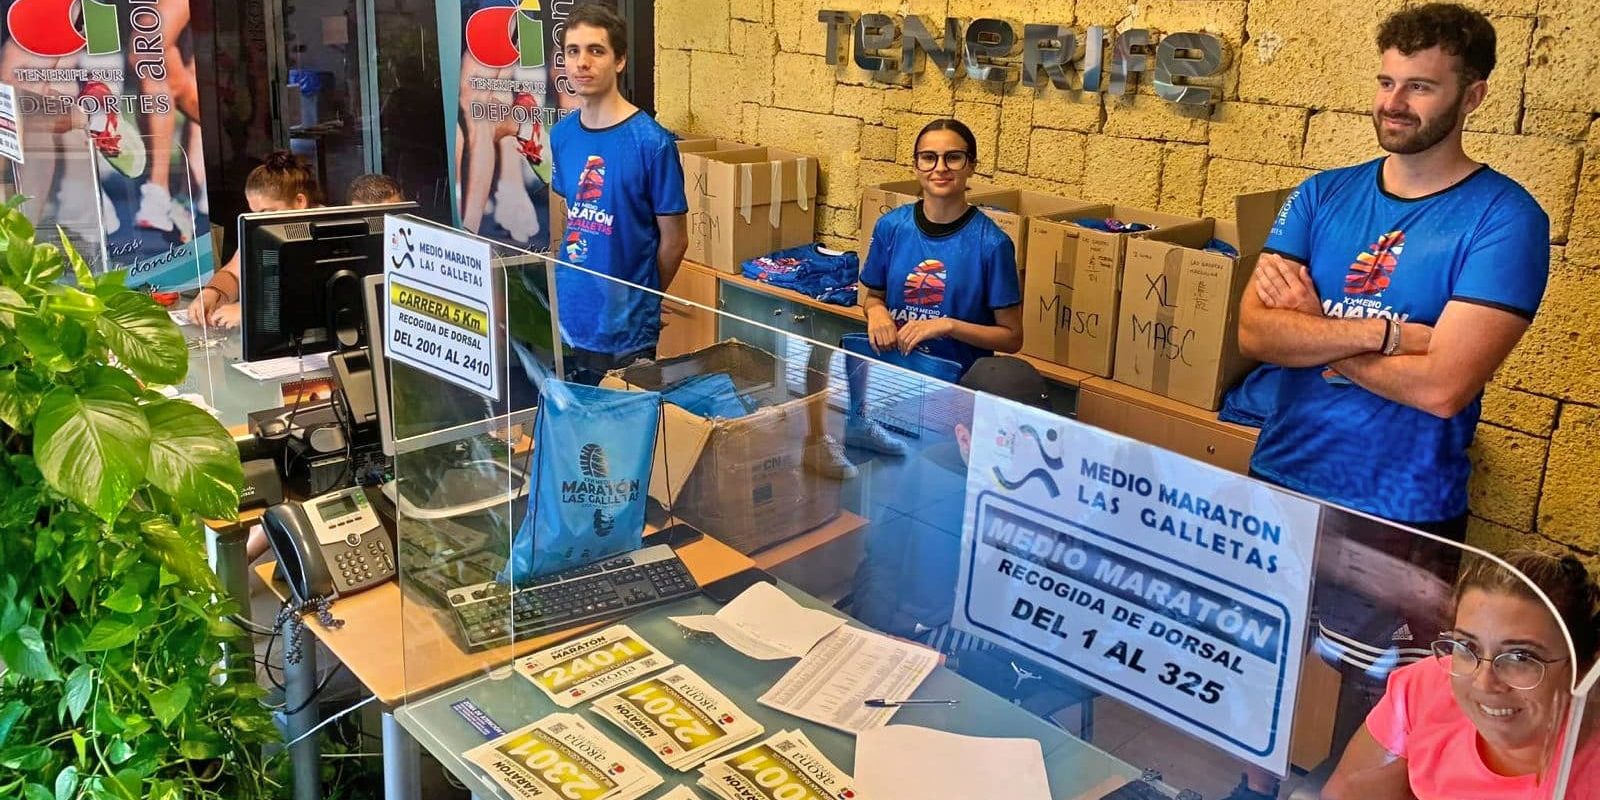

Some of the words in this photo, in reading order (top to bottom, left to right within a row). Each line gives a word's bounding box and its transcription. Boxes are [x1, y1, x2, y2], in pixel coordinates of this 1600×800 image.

[15, 68, 89, 82] TENERIFE
[91, 68, 125, 82] SUR
[19, 95, 170, 115] DEPORTES
[693, 172, 717, 198] XL
[419, 241, 443, 258] MEDIO
[444, 249, 482, 270] MARATON
[420, 259, 435, 272] LAS
[440, 263, 483, 288] GALLETAS
[399, 291, 450, 320] CARRERA
[453, 309, 461, 323] 5
[462, 311, 481, 330] Km
[1145, 273, 1179, 308] XL
[398, 312, 437, 333] RECOGIDA
[438, 326, 449, 338] DE
[451, 329, 482, 350] DORSAL
[1039, 294, 1099, 339] MASC
[394, 329, 413, 347] DEL
[416, 338, 442, 358] 2001
[445, 348, 460, 365] AL
[463, 355, 490, 377] 2410
[1132, 314, 1196, 367] MASC
[562, 494, 585, 504] LAS
[1080, 458, 1153, 497] MEDIO
[1158, 483, 1281, 545] MARATON
[1078, 485, 1120, 515] LAS
[1140, 508, 1278, 574] GALLETAS
[987, 516, 1088, 571] MEDIO
[1095, 558, 1276, 649] MARATÓN
[998, 558, 1104, 615] RECOGIDA
[1111, 602, 1143, 628] DE
[1148, 618, 1245, 674] DORSAL
[543, 642, 635, 687] 2401
[552, 636, 606, 661] MARATÓN
[1010, 597, 1067, 639] DEL
[1082, 628, 1095, 649] 1
[1104, 641, 1146, 673] AL
[1158, 662, 1225, 705] 325
[628, 687, 711, 743] 2201
[507, 738, 600, 799] 2301
